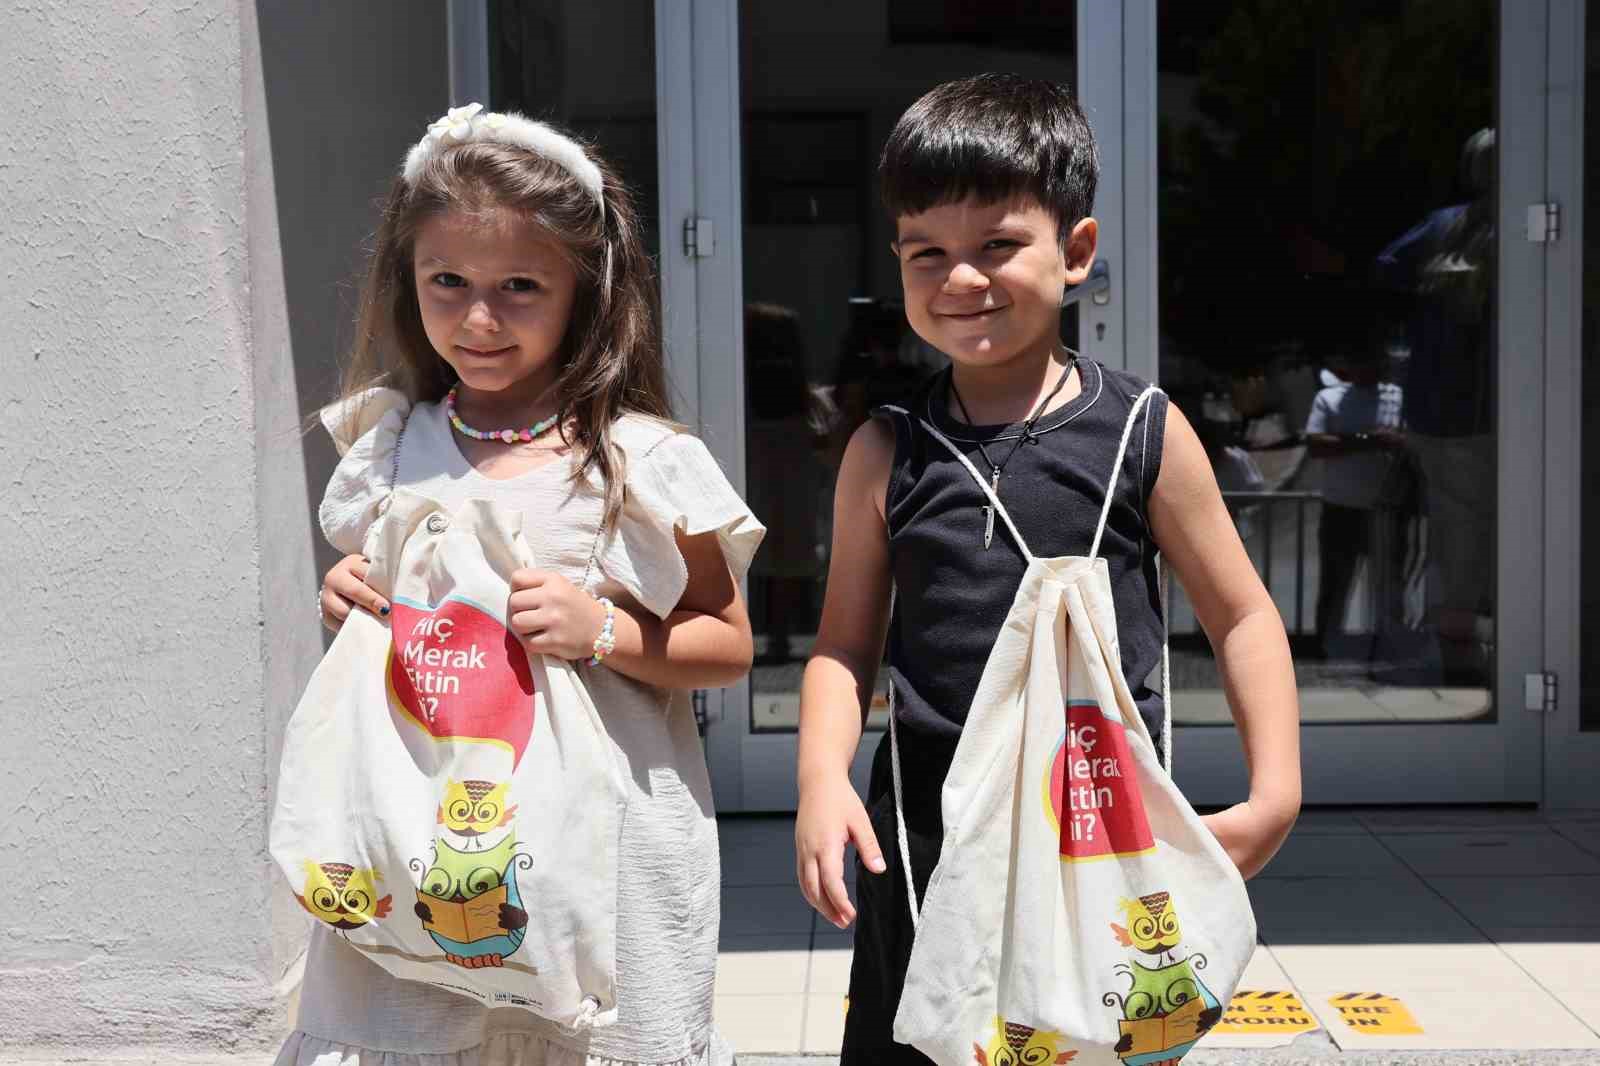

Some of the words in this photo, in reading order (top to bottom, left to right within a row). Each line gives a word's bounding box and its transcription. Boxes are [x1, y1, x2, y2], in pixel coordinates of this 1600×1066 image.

[404, 640, 487, 669] Merak
[1067, 721, 1097, 752] iç
[1069, 782, 1113, 811] ttin
[1222, 1016, 1310, 1025] KORU
